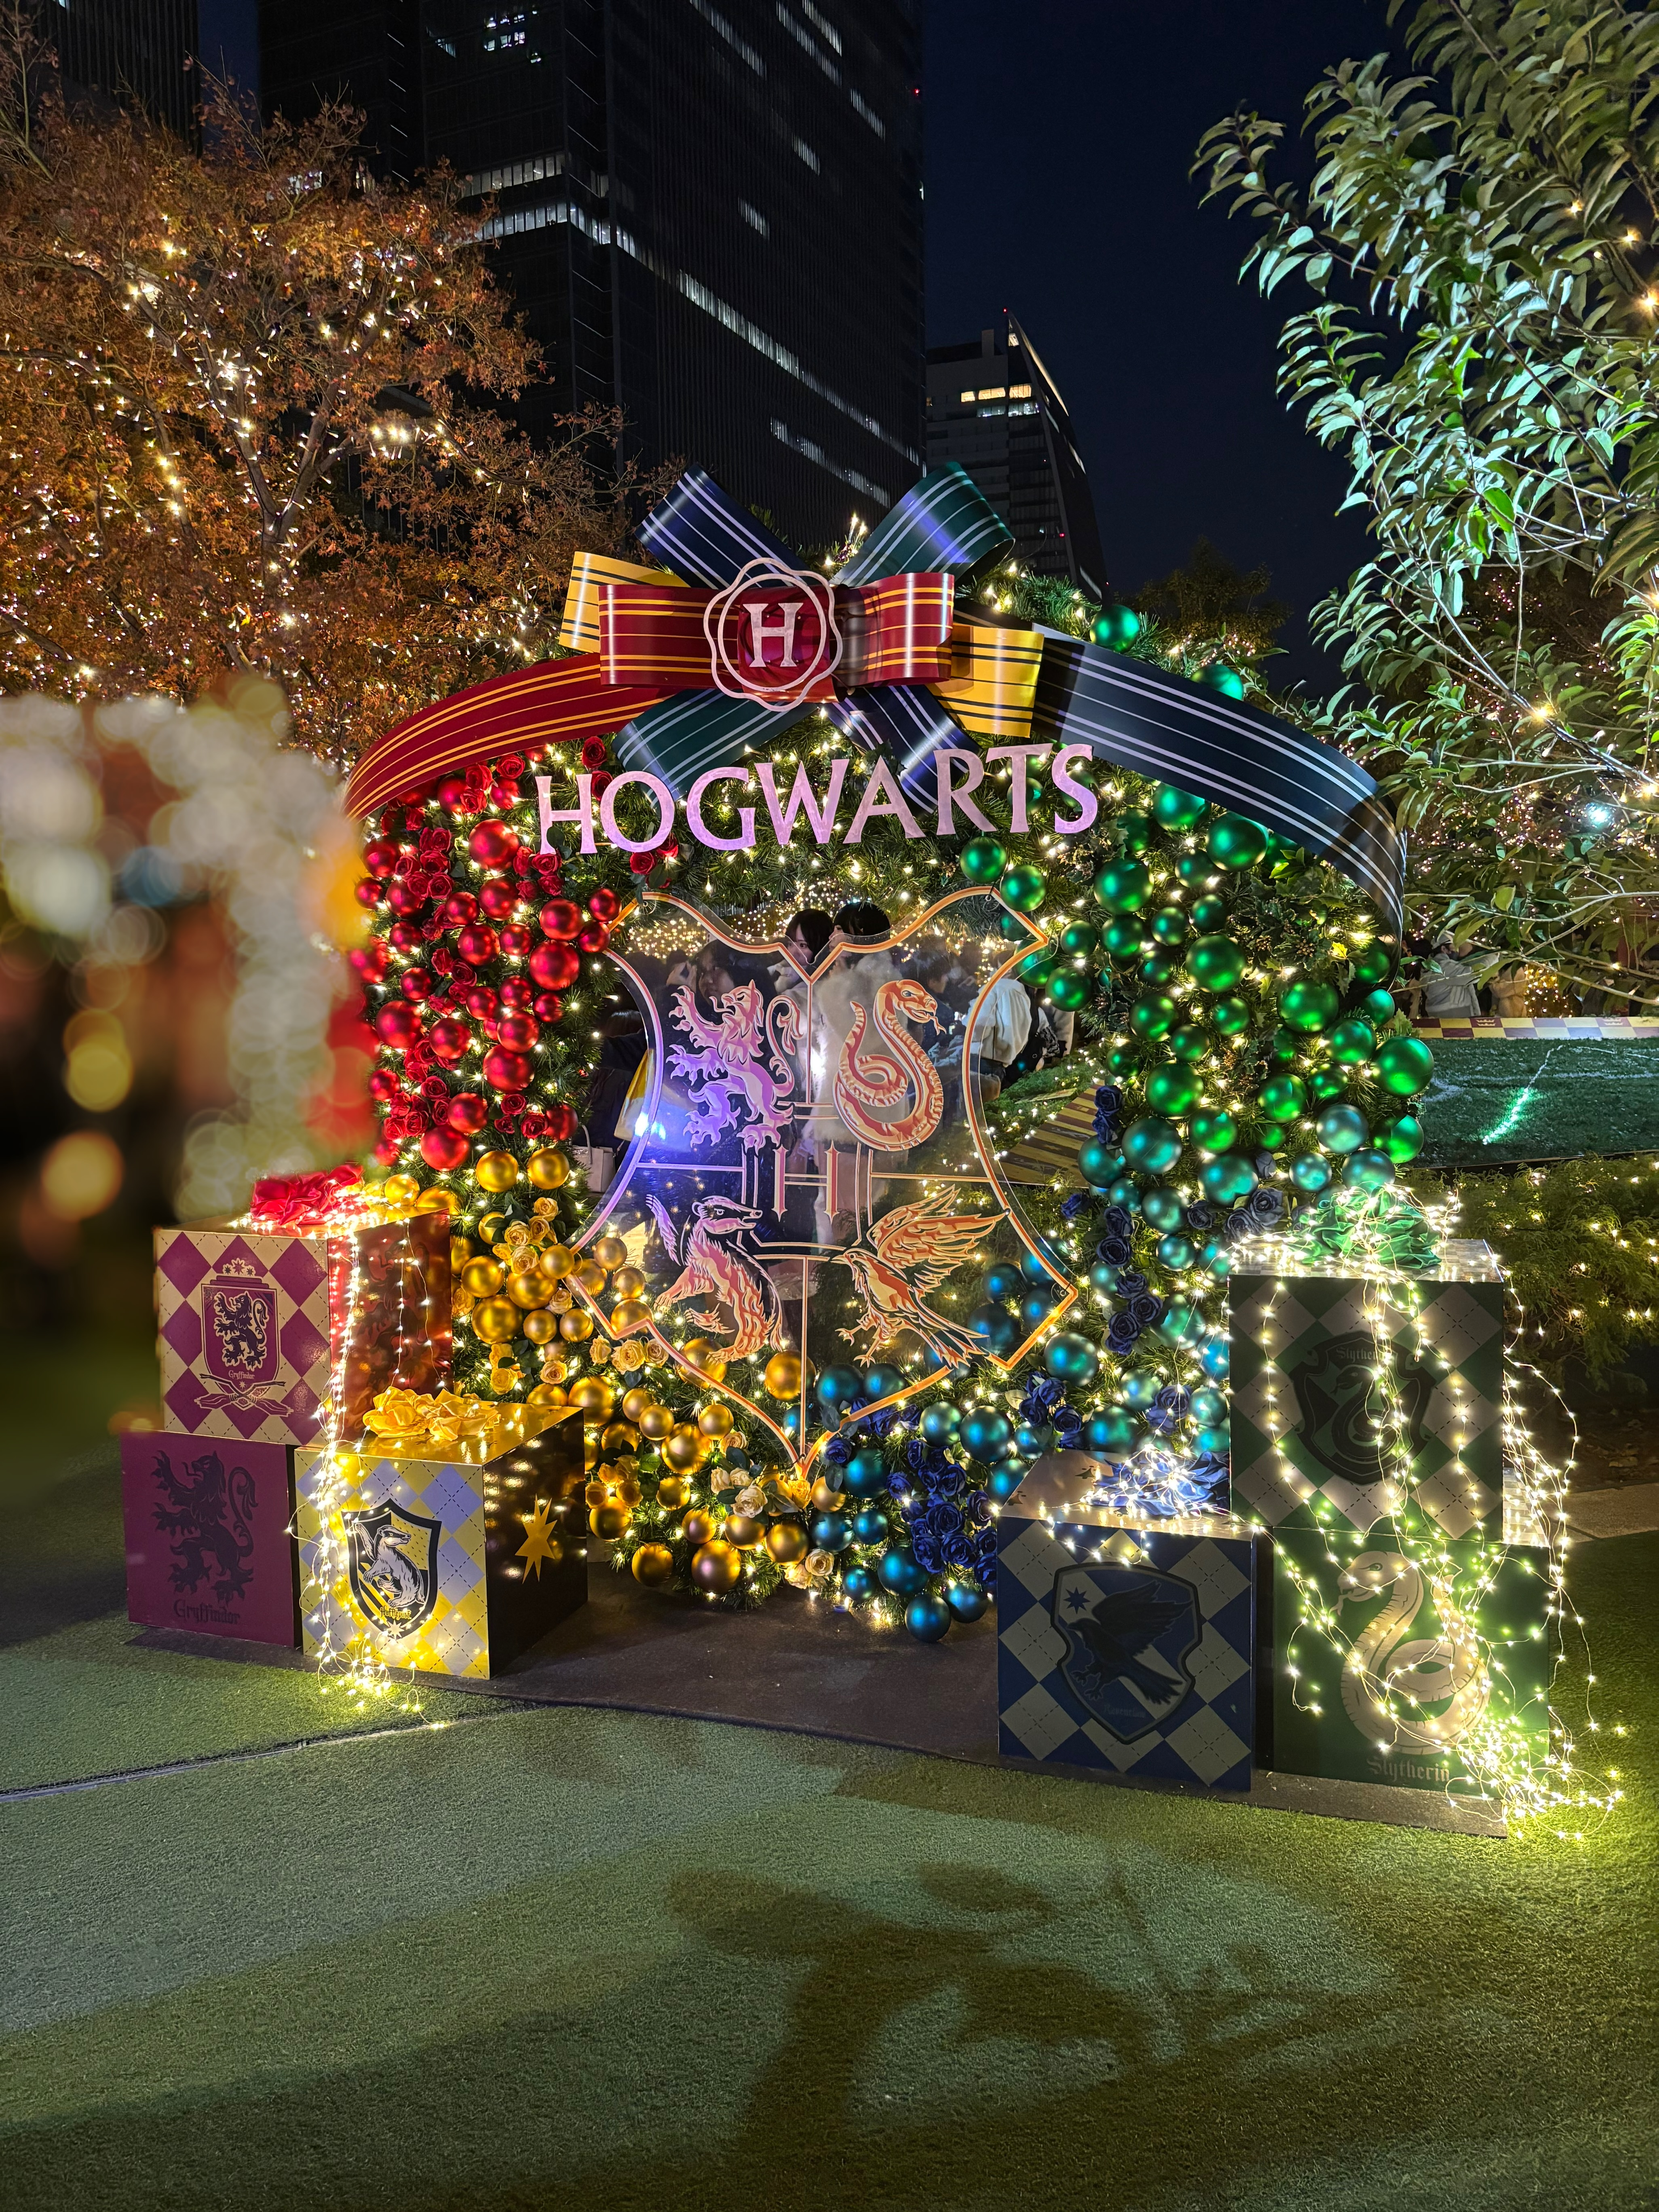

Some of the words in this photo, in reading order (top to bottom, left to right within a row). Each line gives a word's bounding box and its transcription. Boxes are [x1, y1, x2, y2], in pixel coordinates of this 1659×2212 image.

[743, 602, 804, 669] H
[534, 743, 1098, 855] HOGWARTS
[1336, 1346, 1387, 1364] Slyther
[228, 1370, 255, 1380] Gryffindor
[173, 1598, 241, 1625] Gryffindor
[1366, 1756, 1450, 1782] Slytherin
